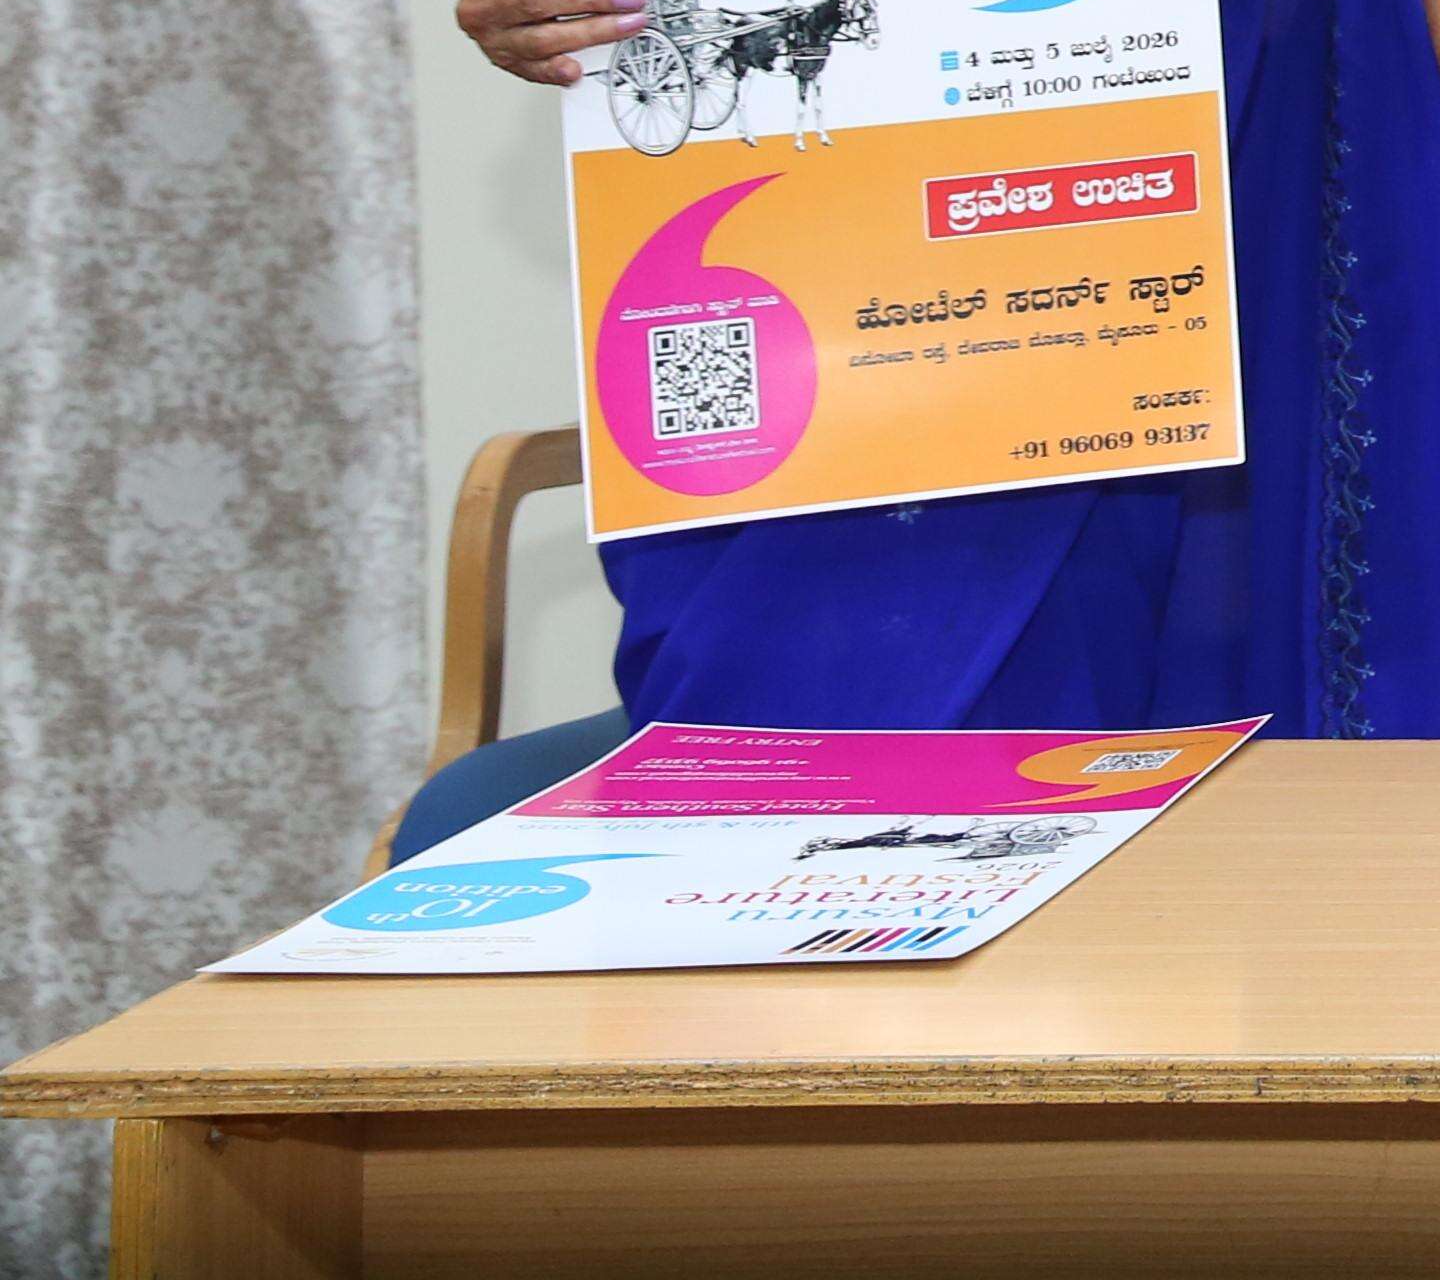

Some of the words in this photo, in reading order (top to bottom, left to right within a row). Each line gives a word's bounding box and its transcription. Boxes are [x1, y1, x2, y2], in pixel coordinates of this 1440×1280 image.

[966, 51, 980, 67] 4
[991, 47, 1034, 70] ಮತ್ತು
[1047, 43, 1059, 59] 5
[1122, 31, 1178, 51] 2026
[1023, 75, 1081, 96] 10:00
[947, 177, 1054, 232] ಪ್ರವೇಶ
[1072, 168, 1174, 206] ಉಚಿತ
[856, 288, 986, 329] ಹೋಟೆಲ್
[1007, 277, 1111, 314] ಸದರ್ನ್
[1129, 265, 1205, 312] ಸ್ಟಾರ್
[671, 735, 737, 745] FREE
[973, 861, 1064, 872] 2026
[393, 882, 568, 897] edition
[769, 871, 1044, 889] Festival
[664, 888, 1018, 906] Literature
[365, 898, 501, 924] 10th
[726, 903, 997, 923] Mysuru
